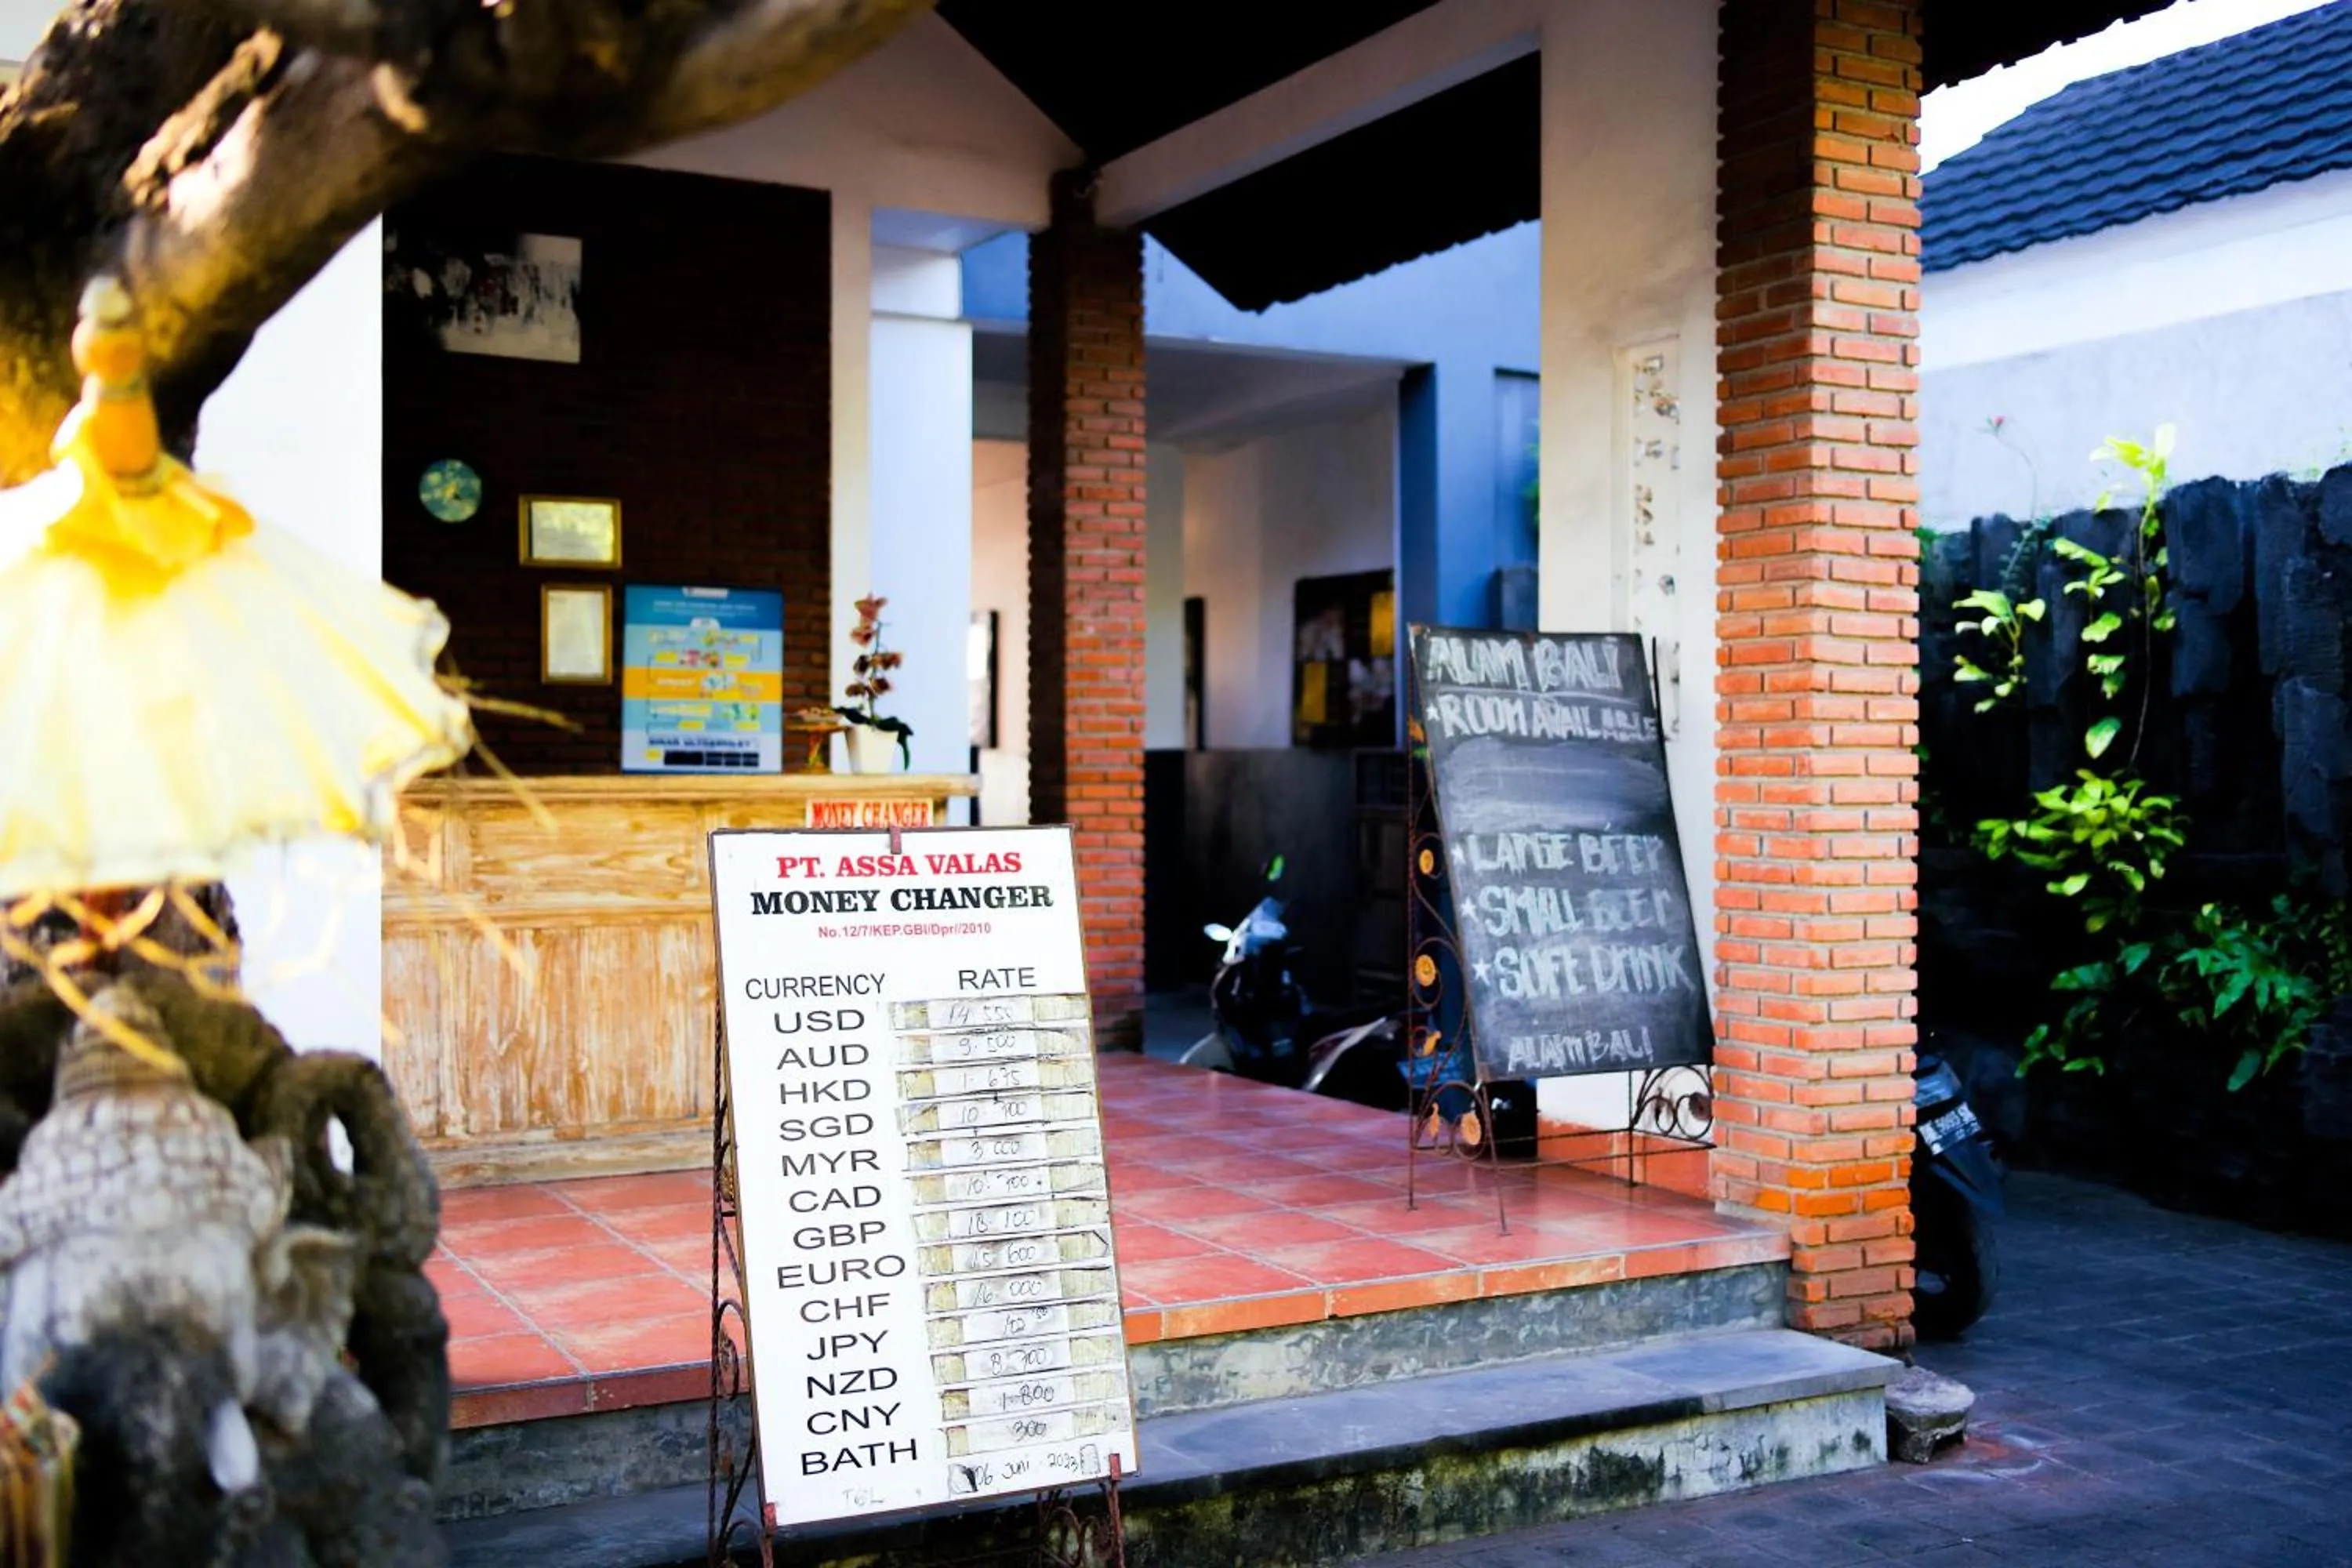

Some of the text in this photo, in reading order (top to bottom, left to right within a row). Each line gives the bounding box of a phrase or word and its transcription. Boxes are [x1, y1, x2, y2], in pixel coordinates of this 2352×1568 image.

[1426, 637, 1531, 691] ALAM
[1438, 694, 1528, 739] ROOM
[811, 800, 929, 828] MONEY CHANGER
[777, 852, 1023, 879] PT. ASSA VALAS
[750, 885, 1054, 916] MONEY CHANGER
[1478, 885, 1584, 936] SMALL
[745, 967, 1037, 1000] CURRENCY RATE
[774, 1009, 865, 1033] USD
[777, 1044, 869, 1070] AUD
[779, 1080, 871, 1105] HKD
[779, 1113, 874, 1142] SGD
[782, 1149, 880, 1177] MYR
[789, 1185, 881, 1213] CAD
[793, 1221, 886, 1250] GBP
[777, 1254, 906, 1289] EURO
[800, 1293, 891, 1323] CHF
[806, 1330, 888, 1360] JPY
[807, 1367, 898, 1399] NZD
[807, 1403, 901, 1435] CNY
[800, 1438, 917, 1475] BATH
